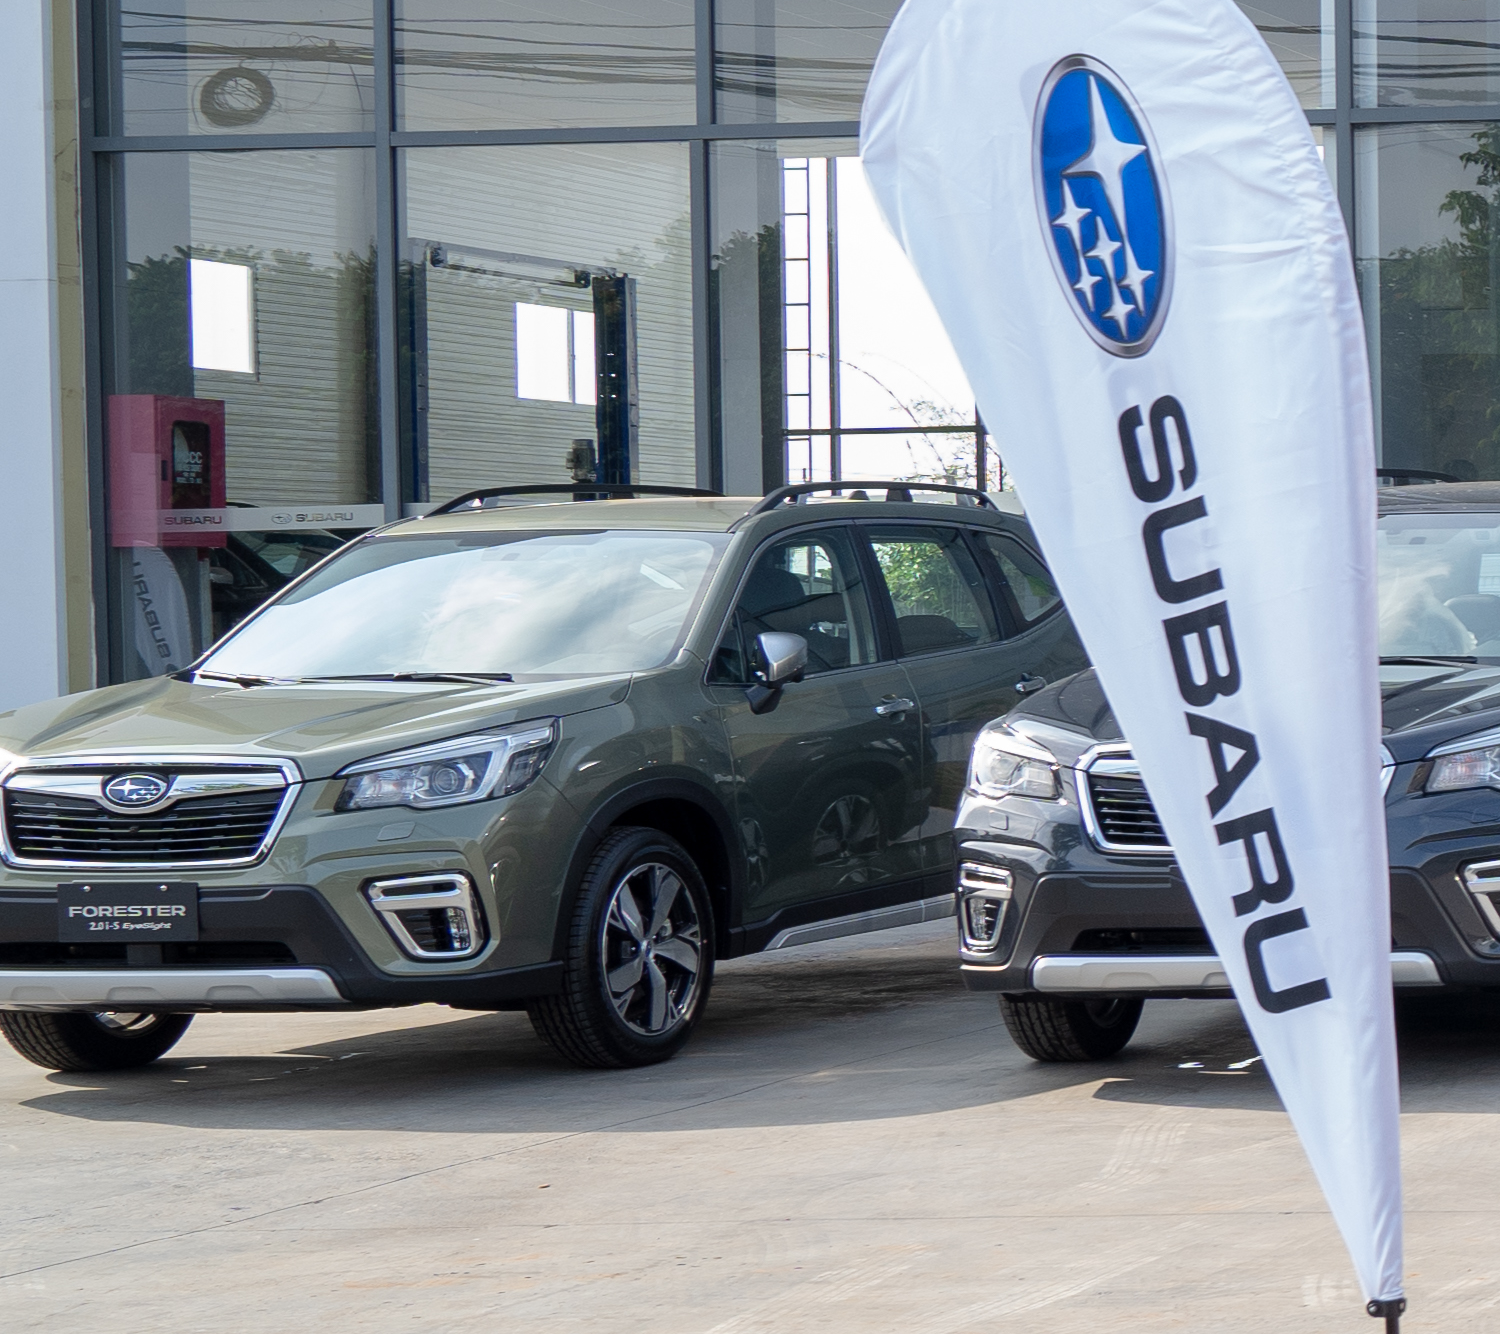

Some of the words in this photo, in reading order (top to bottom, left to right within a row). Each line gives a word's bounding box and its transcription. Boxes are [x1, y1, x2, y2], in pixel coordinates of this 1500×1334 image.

[164, 515, 224, 526] SUBARU
[295, 512, 354, 523] SUBARU
[1118, 394, 1334, 1015] SUBARU
[67, 905, 186, 918] FORESTER
[121, 921, 172, 931] EyeSight
